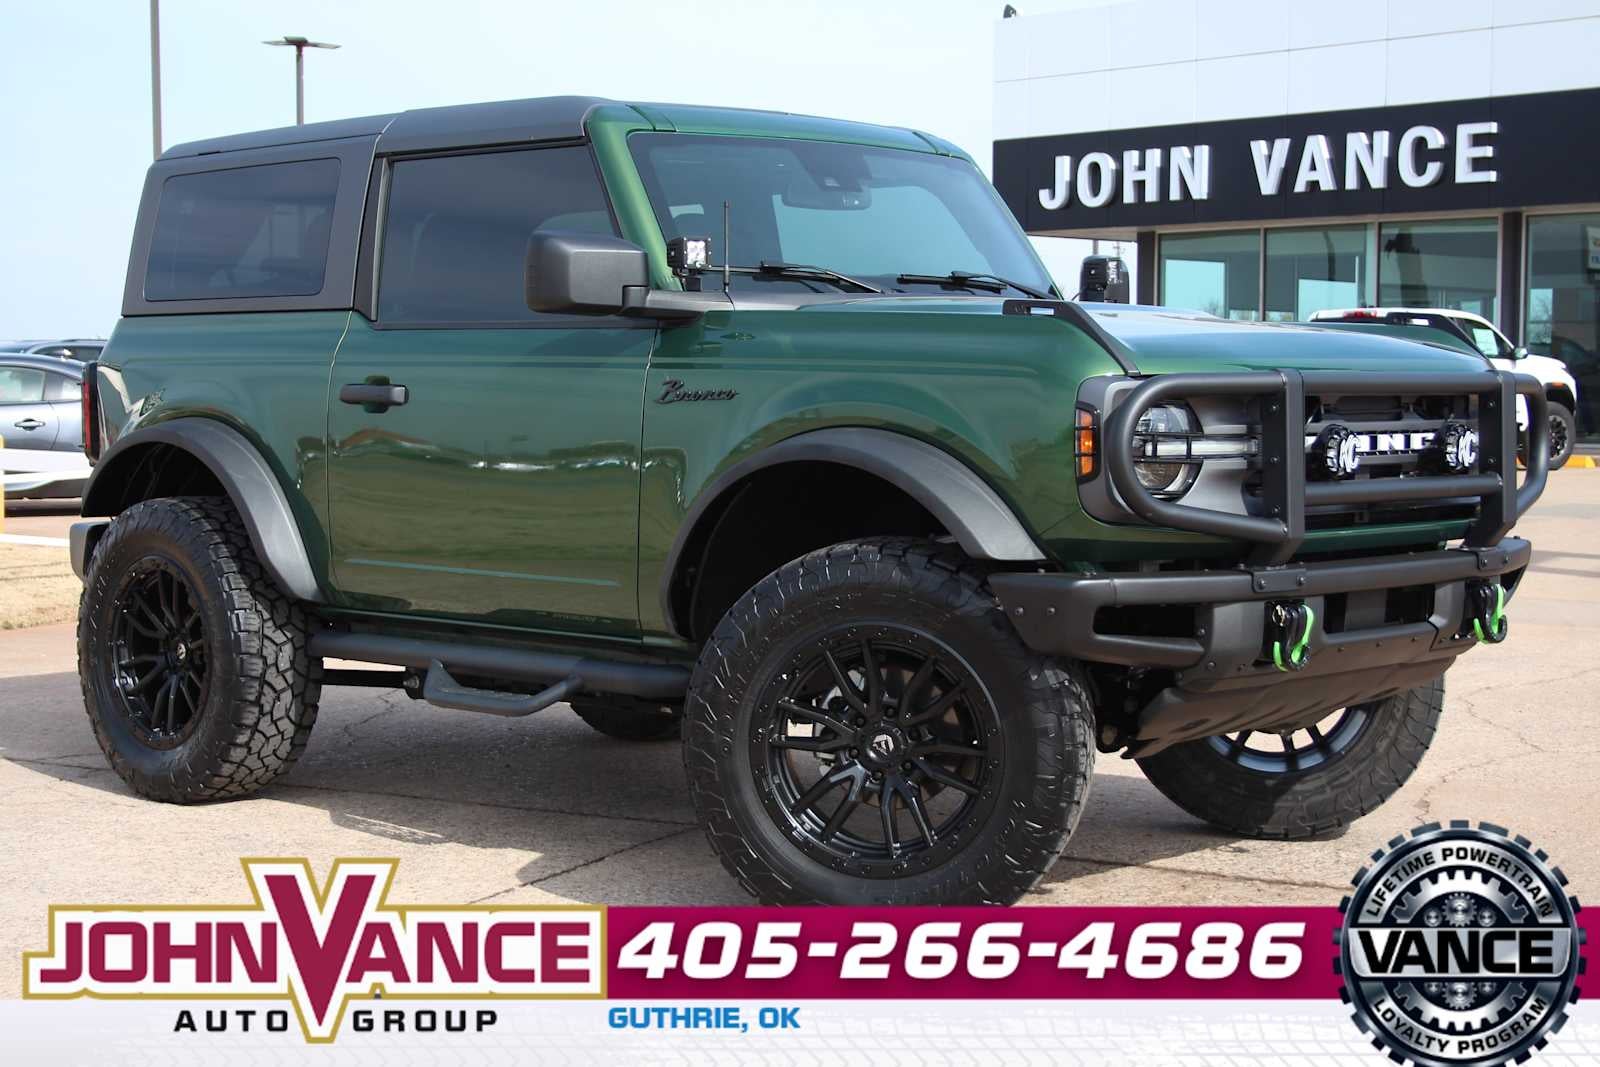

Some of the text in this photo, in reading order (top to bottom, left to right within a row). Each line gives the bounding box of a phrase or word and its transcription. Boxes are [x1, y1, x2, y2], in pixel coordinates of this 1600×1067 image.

[1039, 121, 1499, 210] JOHN VANCE
[656, 379, 740, 404] Bronco
